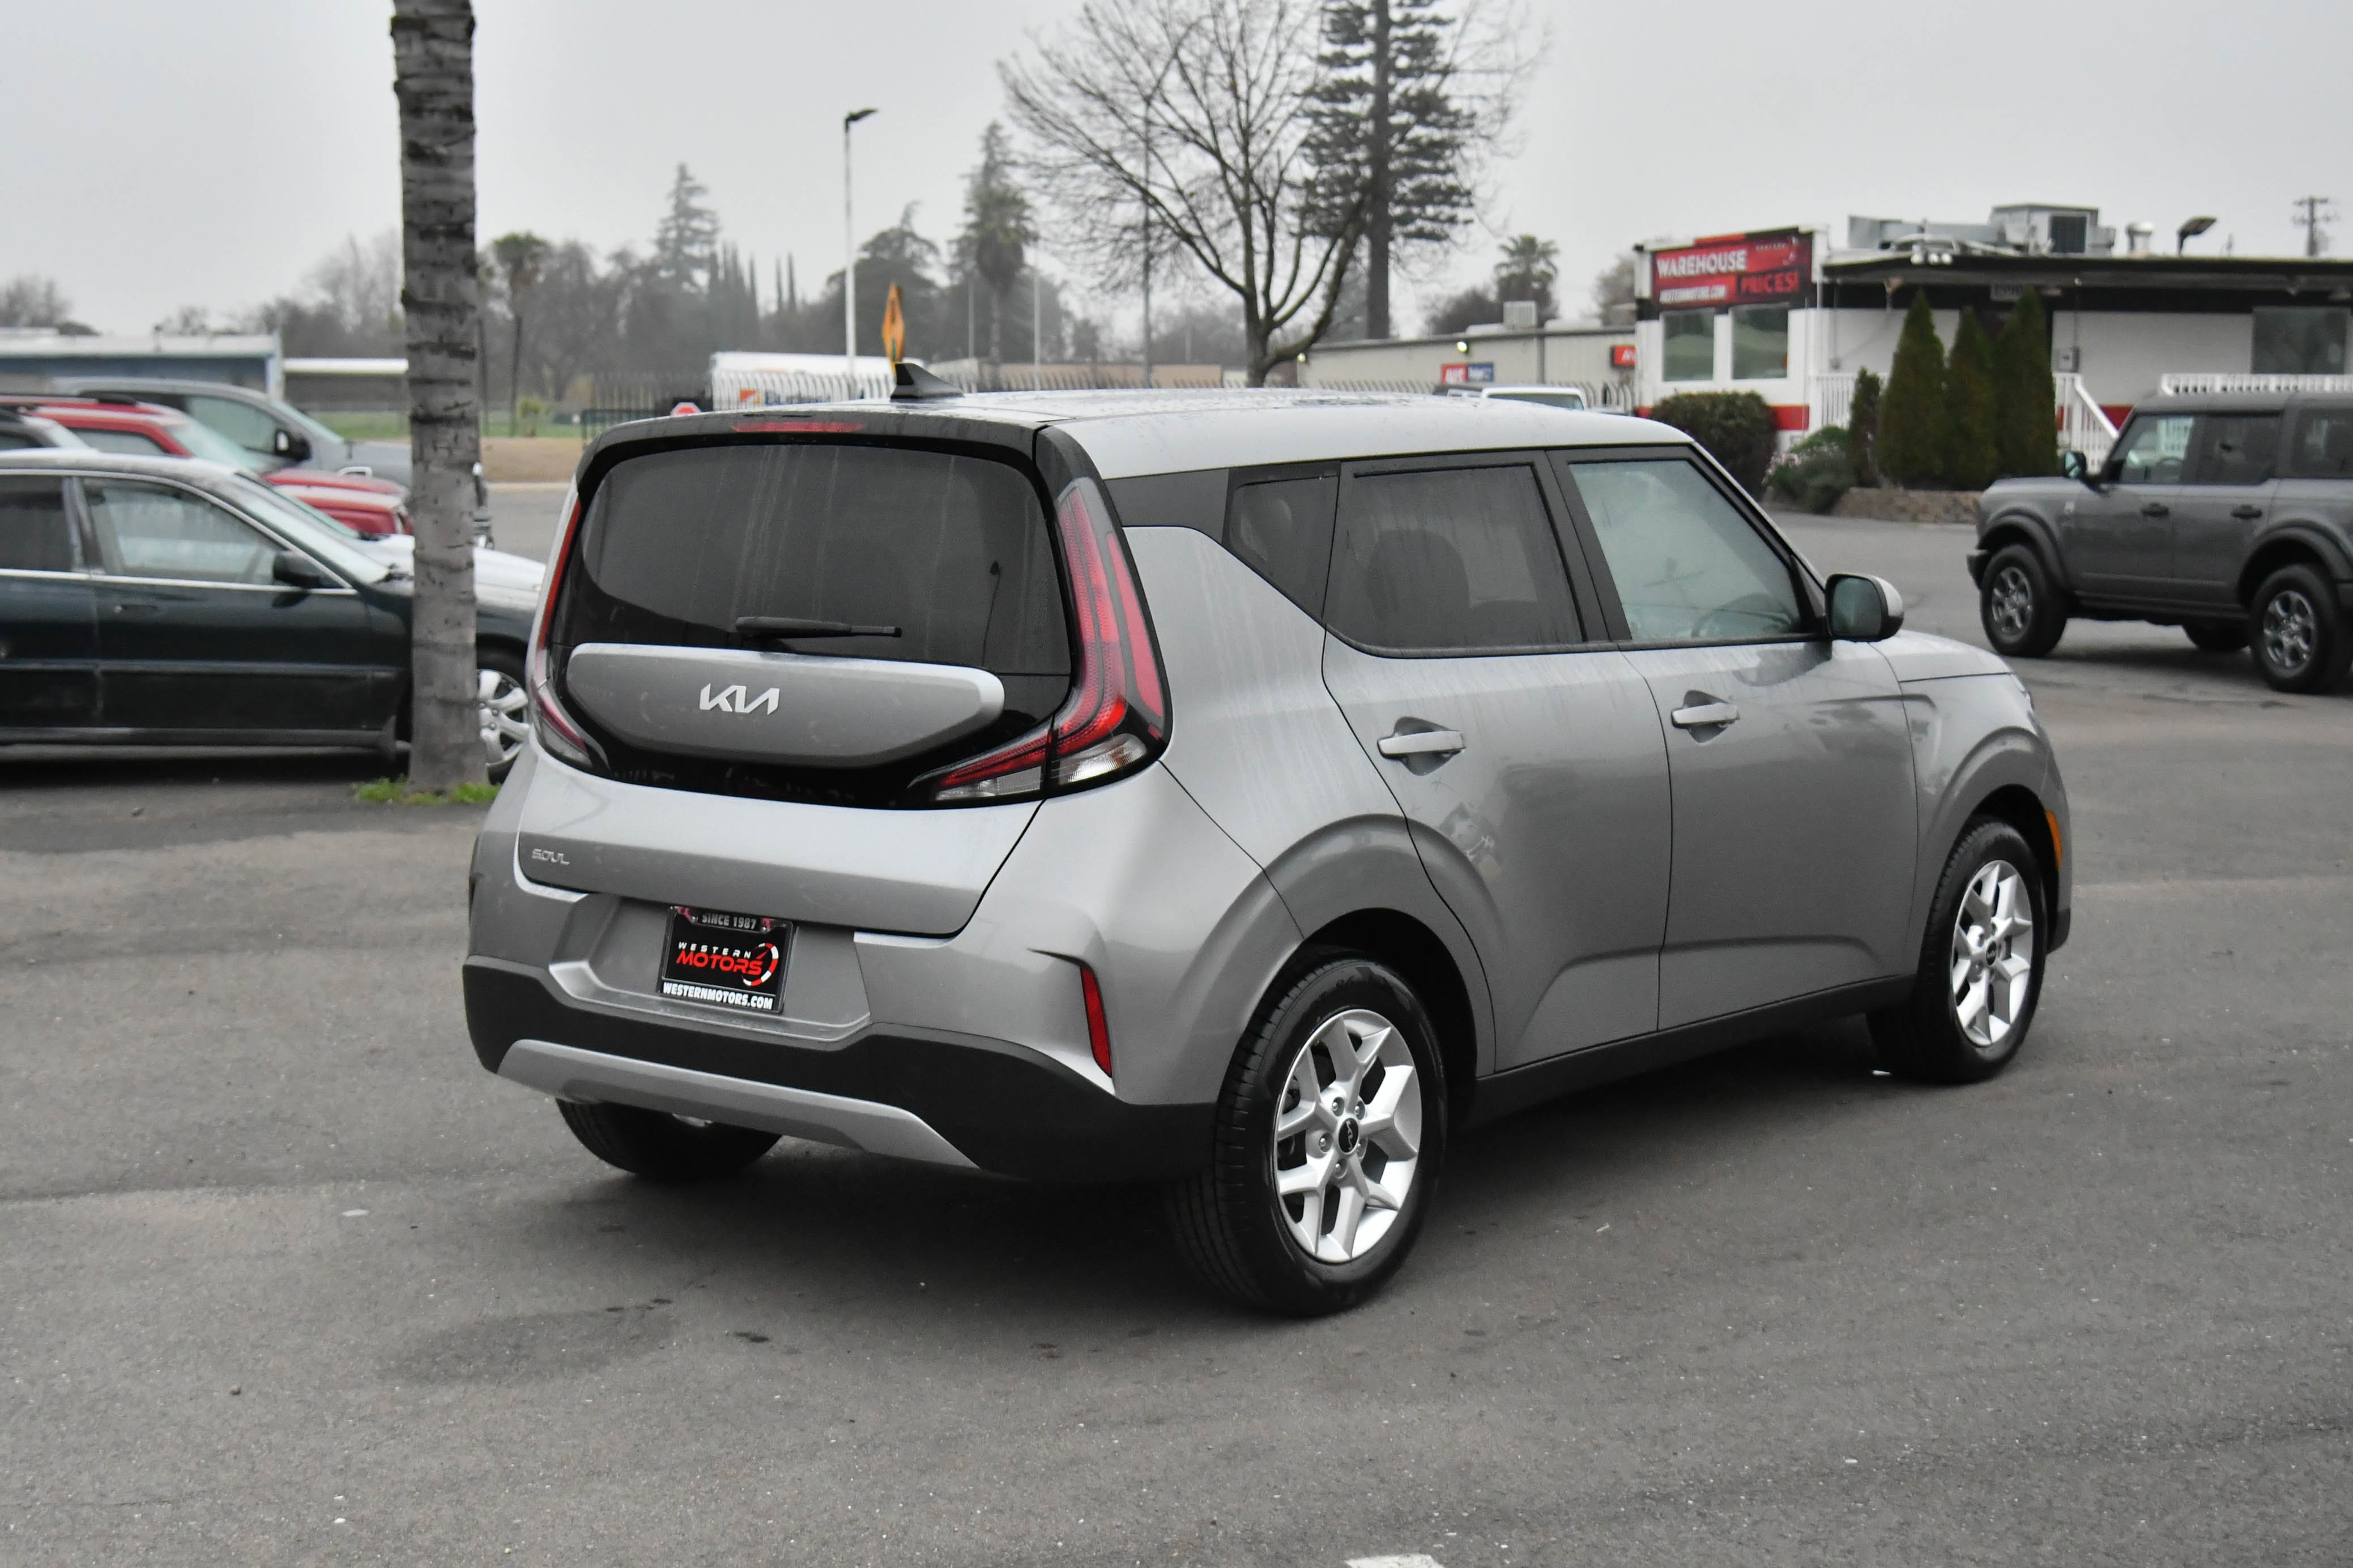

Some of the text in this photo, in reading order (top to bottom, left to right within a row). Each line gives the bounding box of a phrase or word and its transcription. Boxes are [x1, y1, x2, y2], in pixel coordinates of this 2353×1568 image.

[1656, 249, 1747, 279] WAREHOUSE
[699, 682, 780, 716] KIA
[532, 848, 570, 865] SOUL
[702, 913, 757, 930] SINCE 1987
[676, 950, 764, 976] MOTORS
[678, 942, 752, 959] WESTERN
[663, 981, 774, 1010] WESTERNMOTORS.COM
